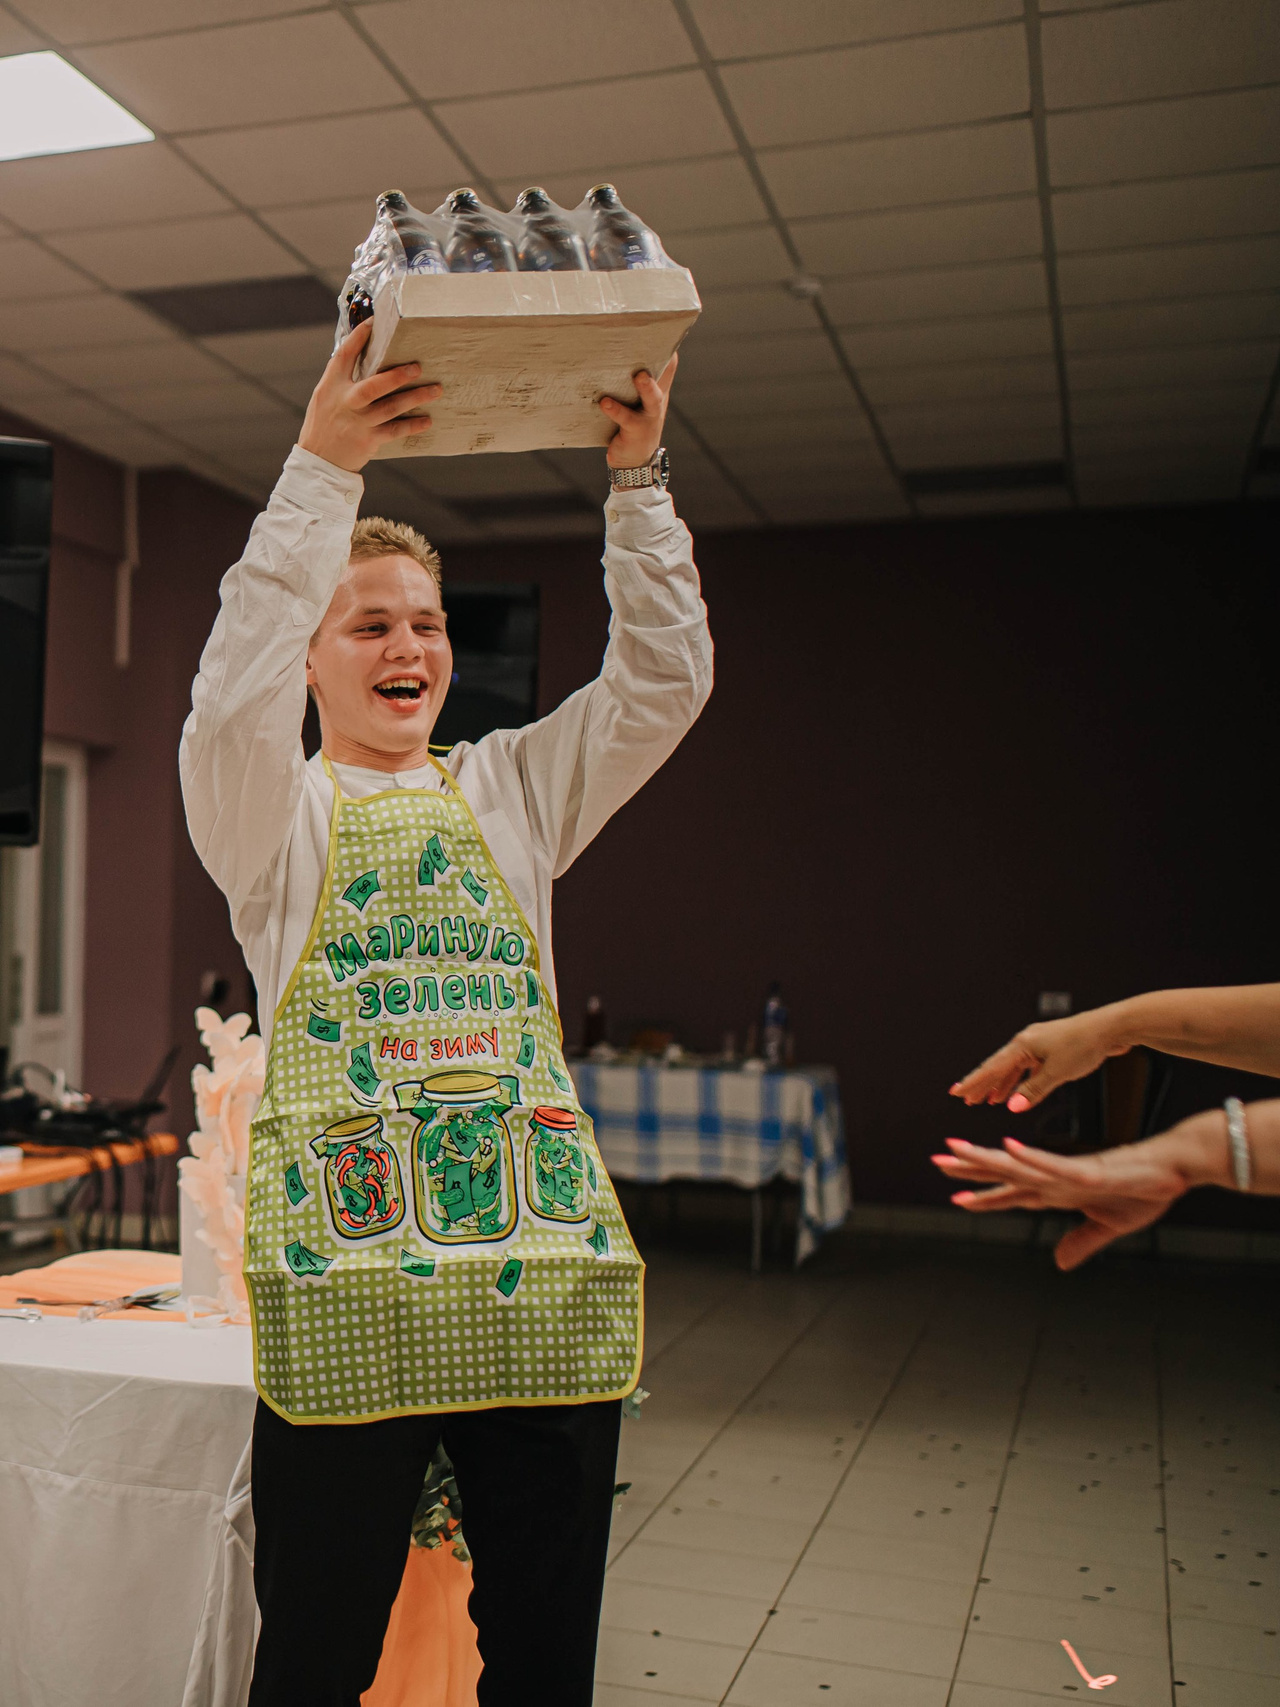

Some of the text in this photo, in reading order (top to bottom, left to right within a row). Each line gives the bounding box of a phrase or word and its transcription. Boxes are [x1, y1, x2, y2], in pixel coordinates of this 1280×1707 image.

[356, 974, 516, 1019] зелень
[379, 1027, 499, 1061] на зиму
